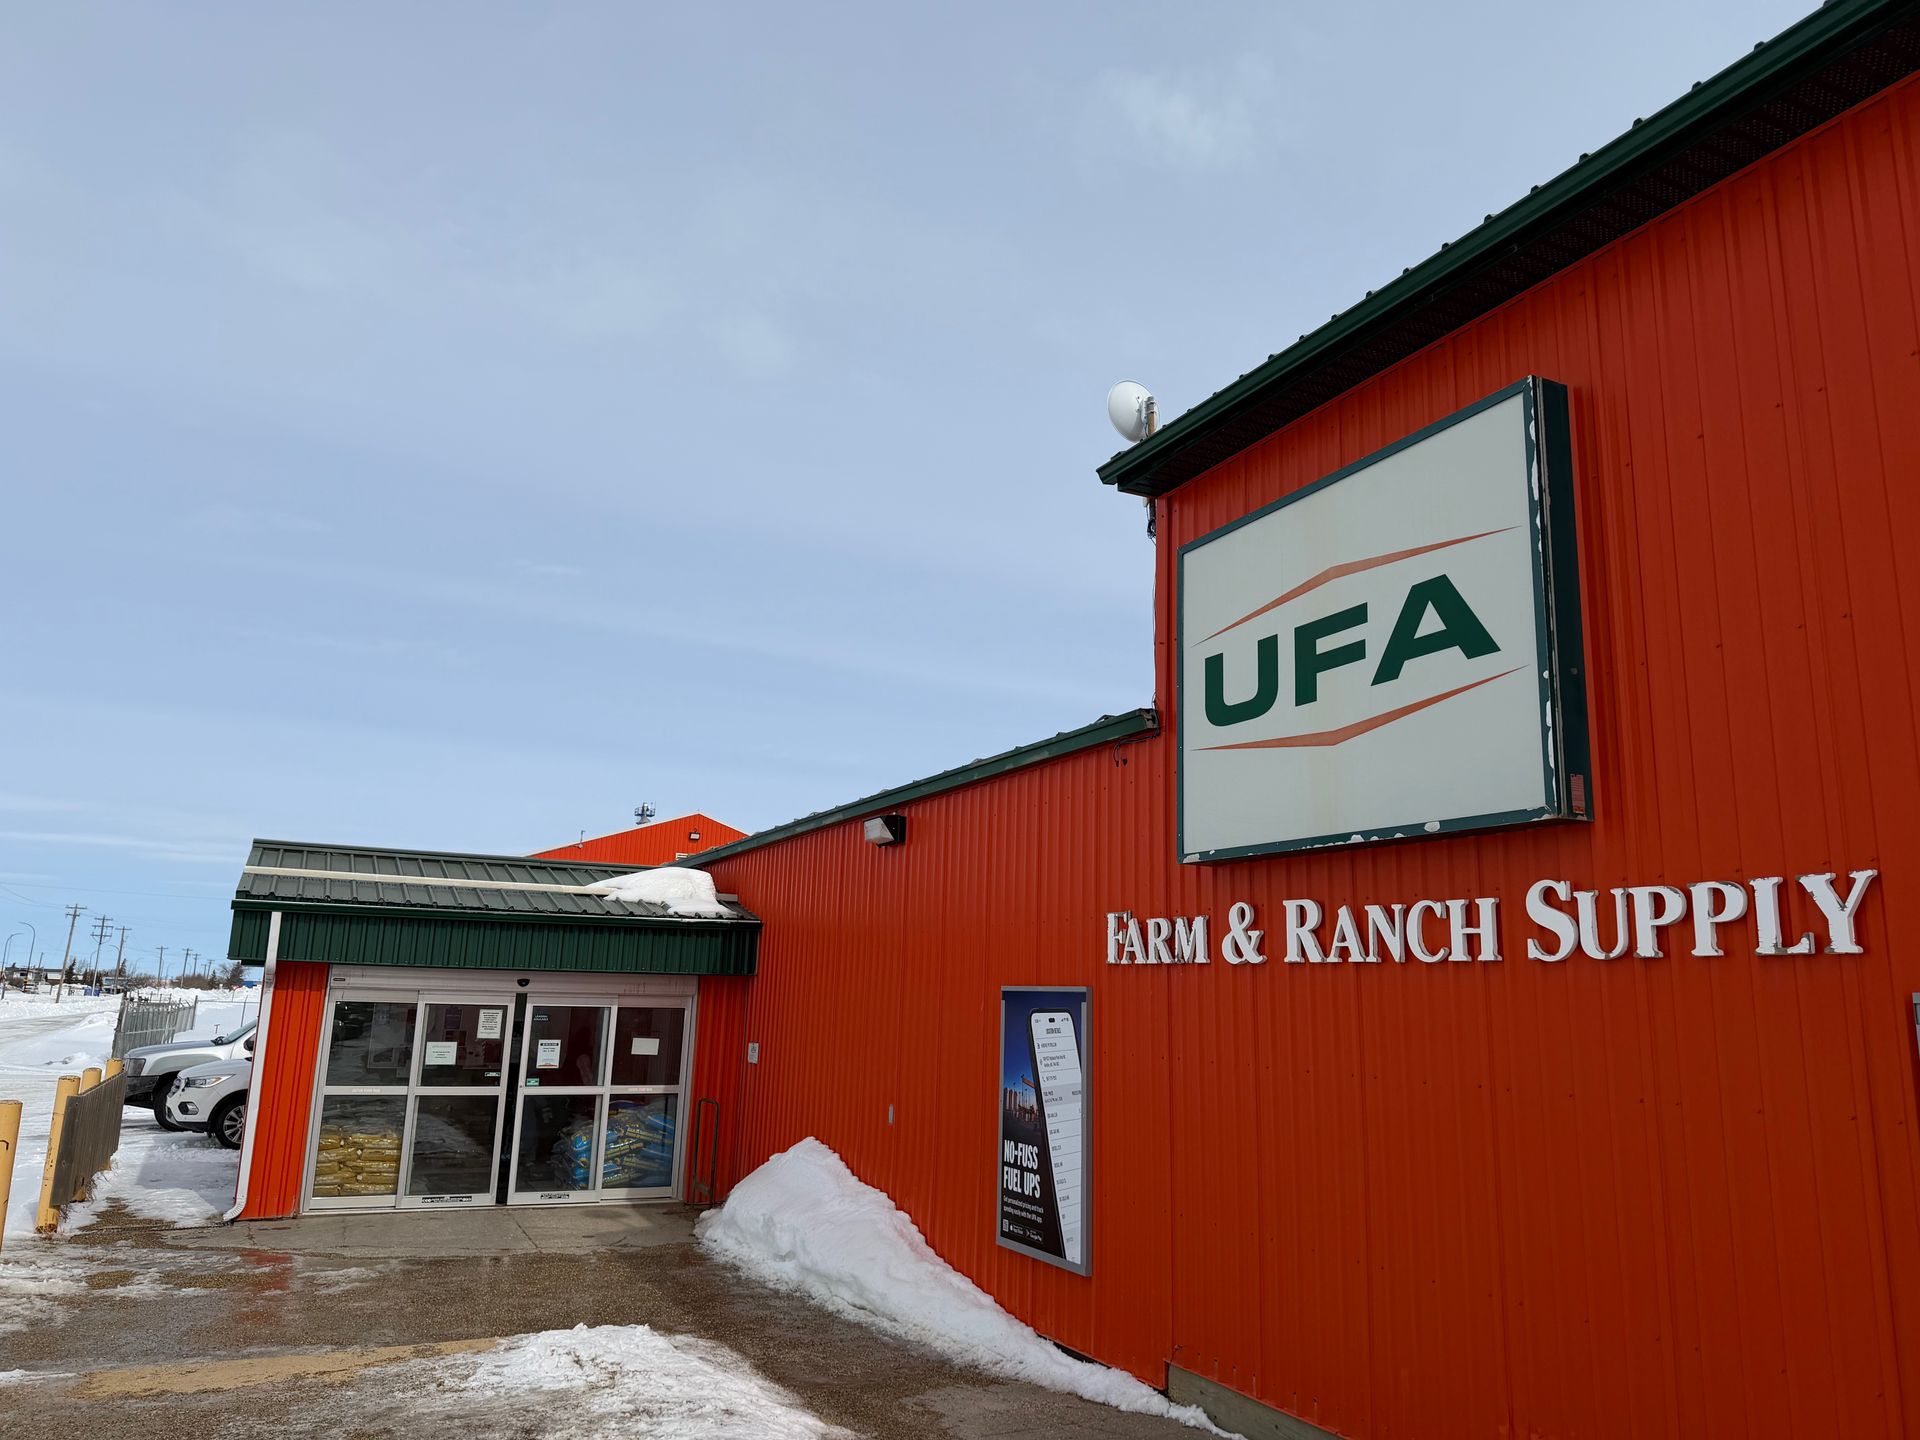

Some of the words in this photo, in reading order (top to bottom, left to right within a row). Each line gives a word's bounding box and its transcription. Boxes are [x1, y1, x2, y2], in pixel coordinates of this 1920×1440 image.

[1205, 574, 1500, 727] UFA
[1105, 909, 1210, 965] FARM
[1222, 901, 1267, 965] &
[1283, 896, 1501, 964] RANCH
[1526, 869, 1878, 962] SUPPLY
[1003, 1139, 1039, 1170] NO-FUSS
[1003, 1165, 1022, 1194] FUEL
[1023, 1171, 1041, 1199] UPS
